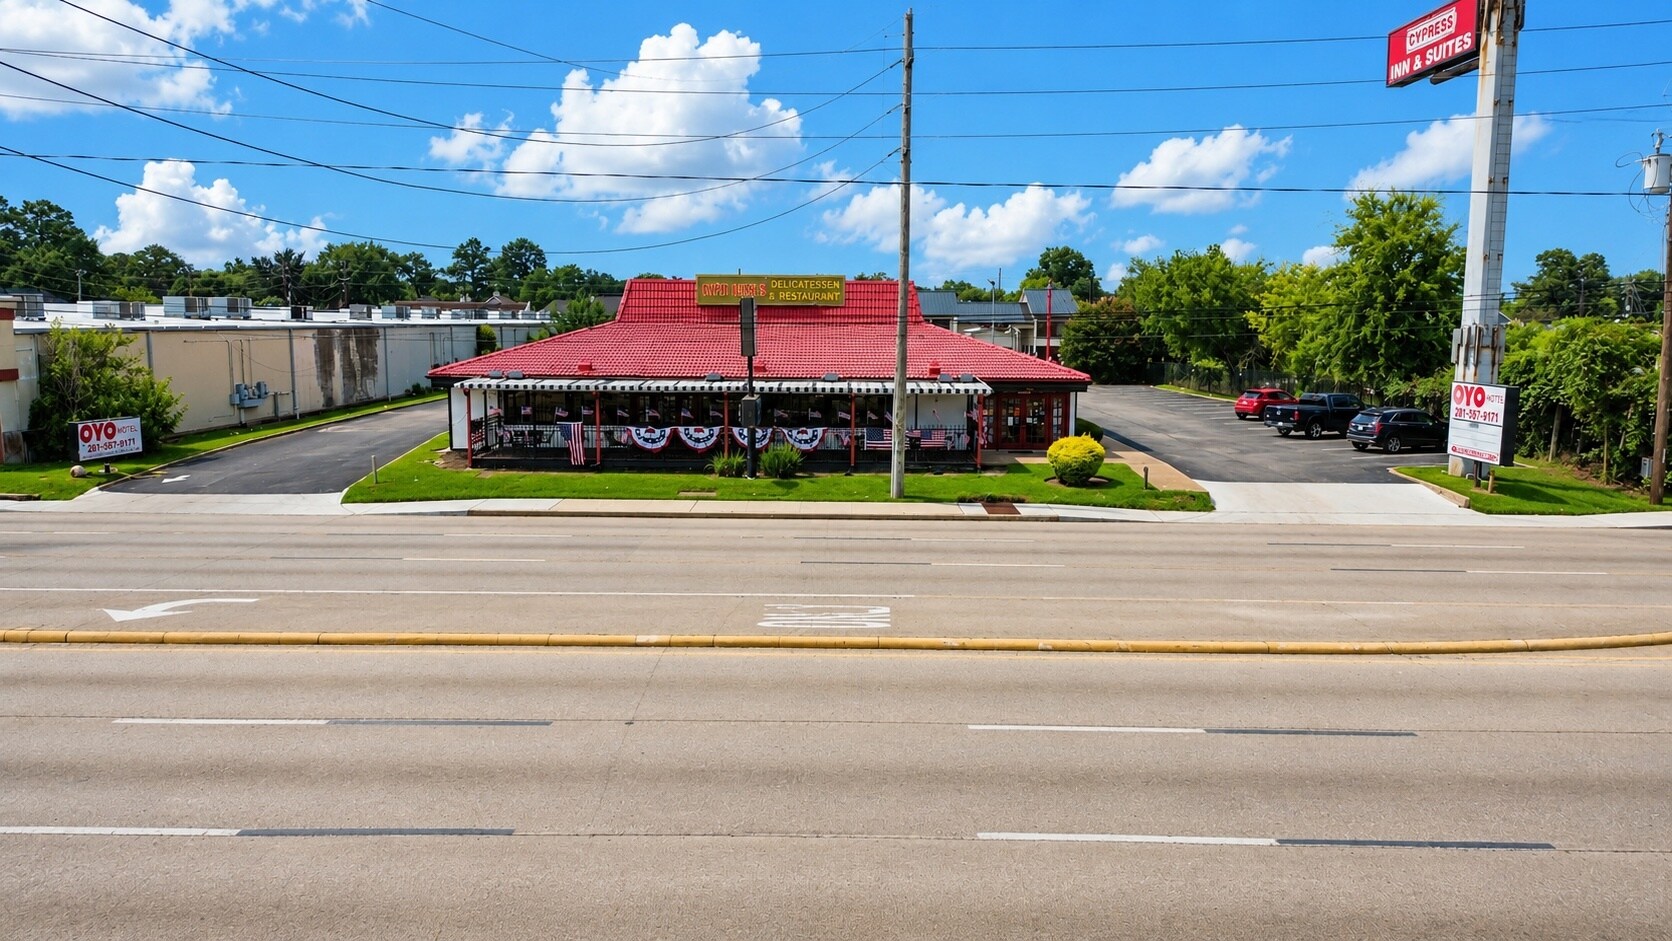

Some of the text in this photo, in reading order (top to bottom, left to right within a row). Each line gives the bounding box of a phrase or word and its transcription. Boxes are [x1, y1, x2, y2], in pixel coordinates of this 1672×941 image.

[1409, 14, 1453, 47] CYPRESS
[1390, 32, 1472, 80] INN & SUITES
[771, 279, 840, 289] DELICATESSEN
[779, 292, 841, 301] RESTAURANT
[1453, 384, 1486, 408] OYO
[80, 421, 117, 444] OYO
